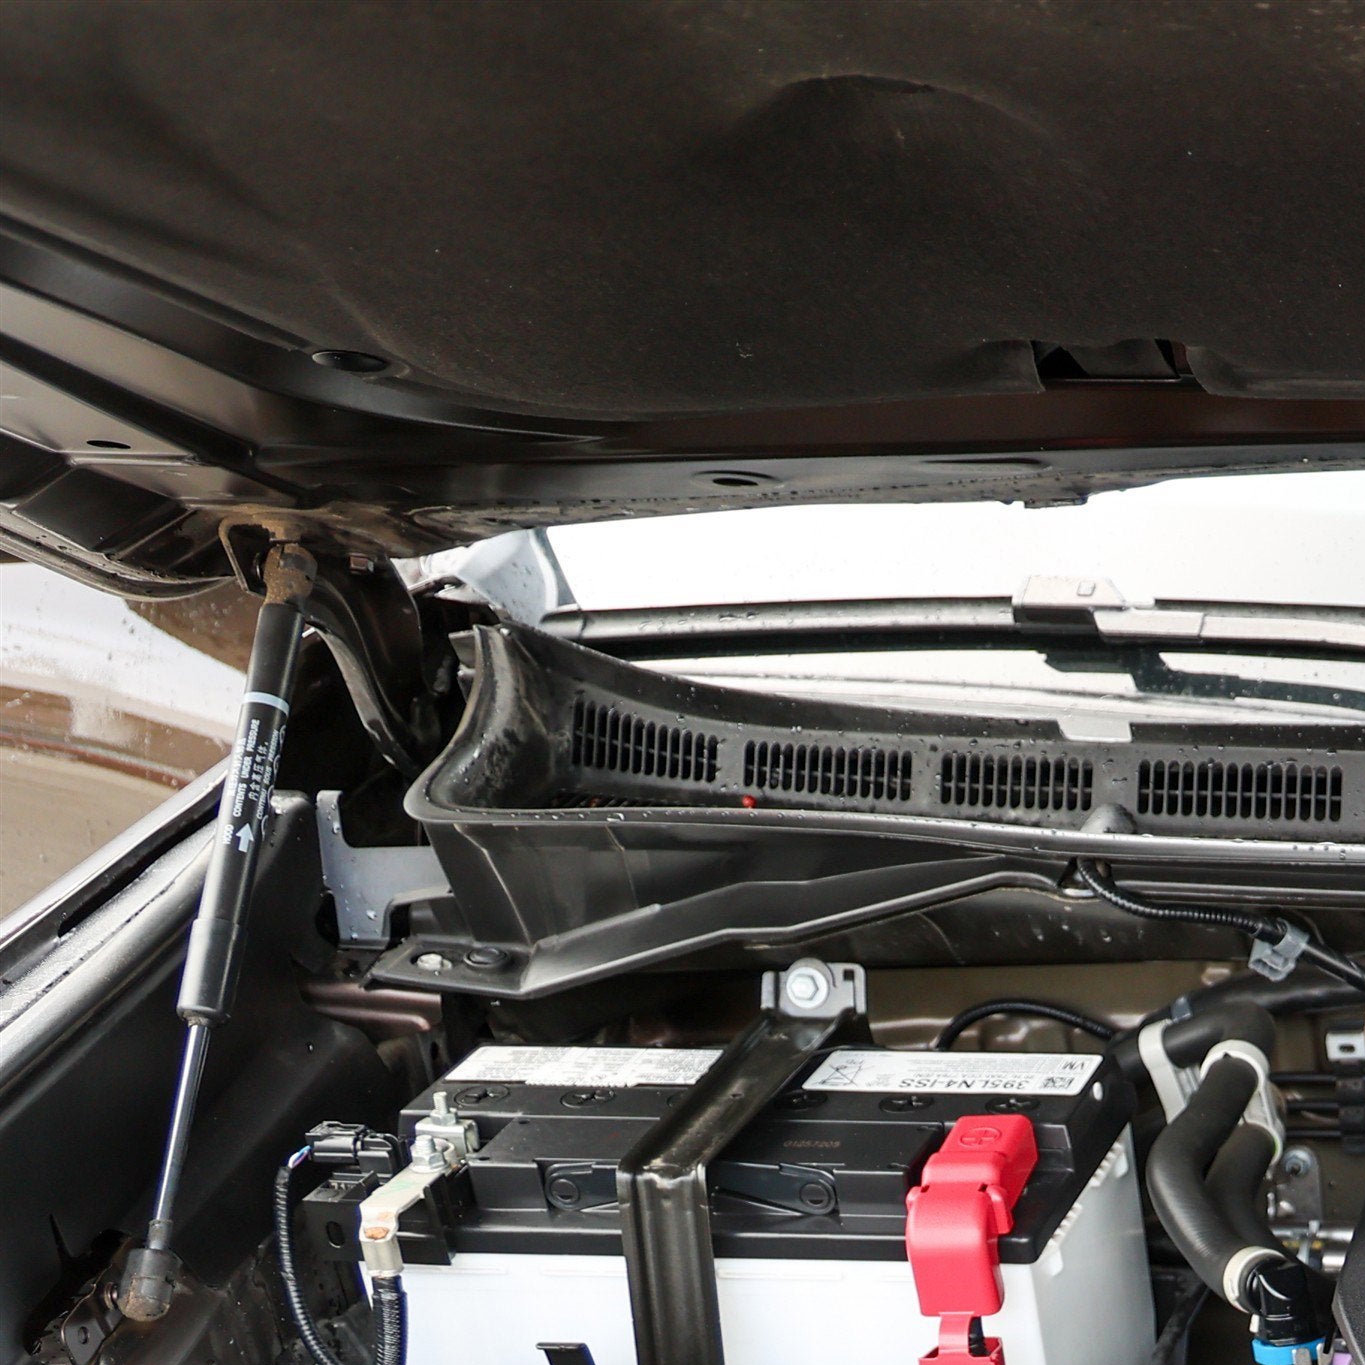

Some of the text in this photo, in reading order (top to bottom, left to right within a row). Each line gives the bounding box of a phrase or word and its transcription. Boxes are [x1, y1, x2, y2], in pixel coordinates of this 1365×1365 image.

[233, 719, 260, 817] CONTENTS UNDER PRESSURE
[223, 824, 234, 844] HOOD
